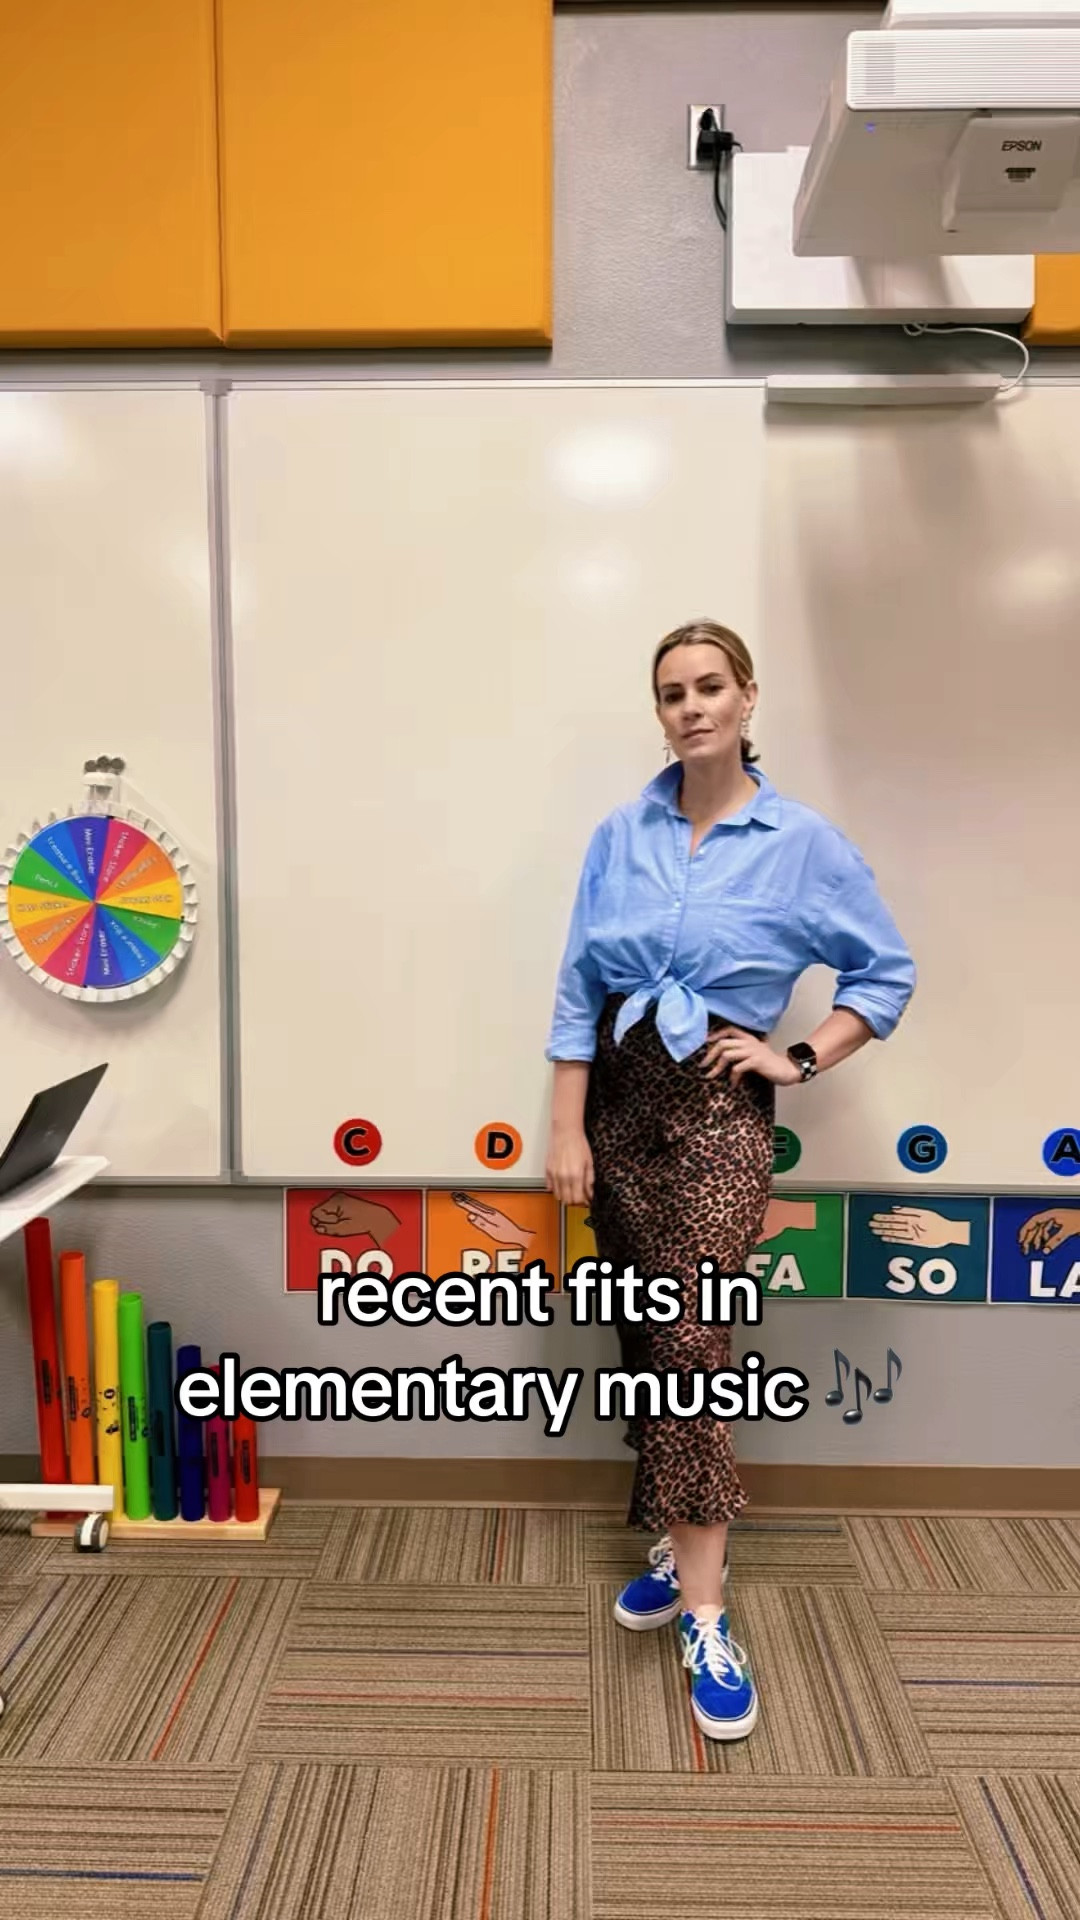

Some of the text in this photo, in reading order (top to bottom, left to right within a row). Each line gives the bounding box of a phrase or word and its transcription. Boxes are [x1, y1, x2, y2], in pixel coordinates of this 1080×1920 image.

[1001, 140, 1042, 152] EPSON
[343, 1127, 371, 1157] C
[486, 1131, 514, 1159] D
[907, 1133, 938, 1164] G
[1050, 1133, 1080, 1164] A
[745, 1252, 807, 1292] FA
[885, 1256, 958, 1296] SO
